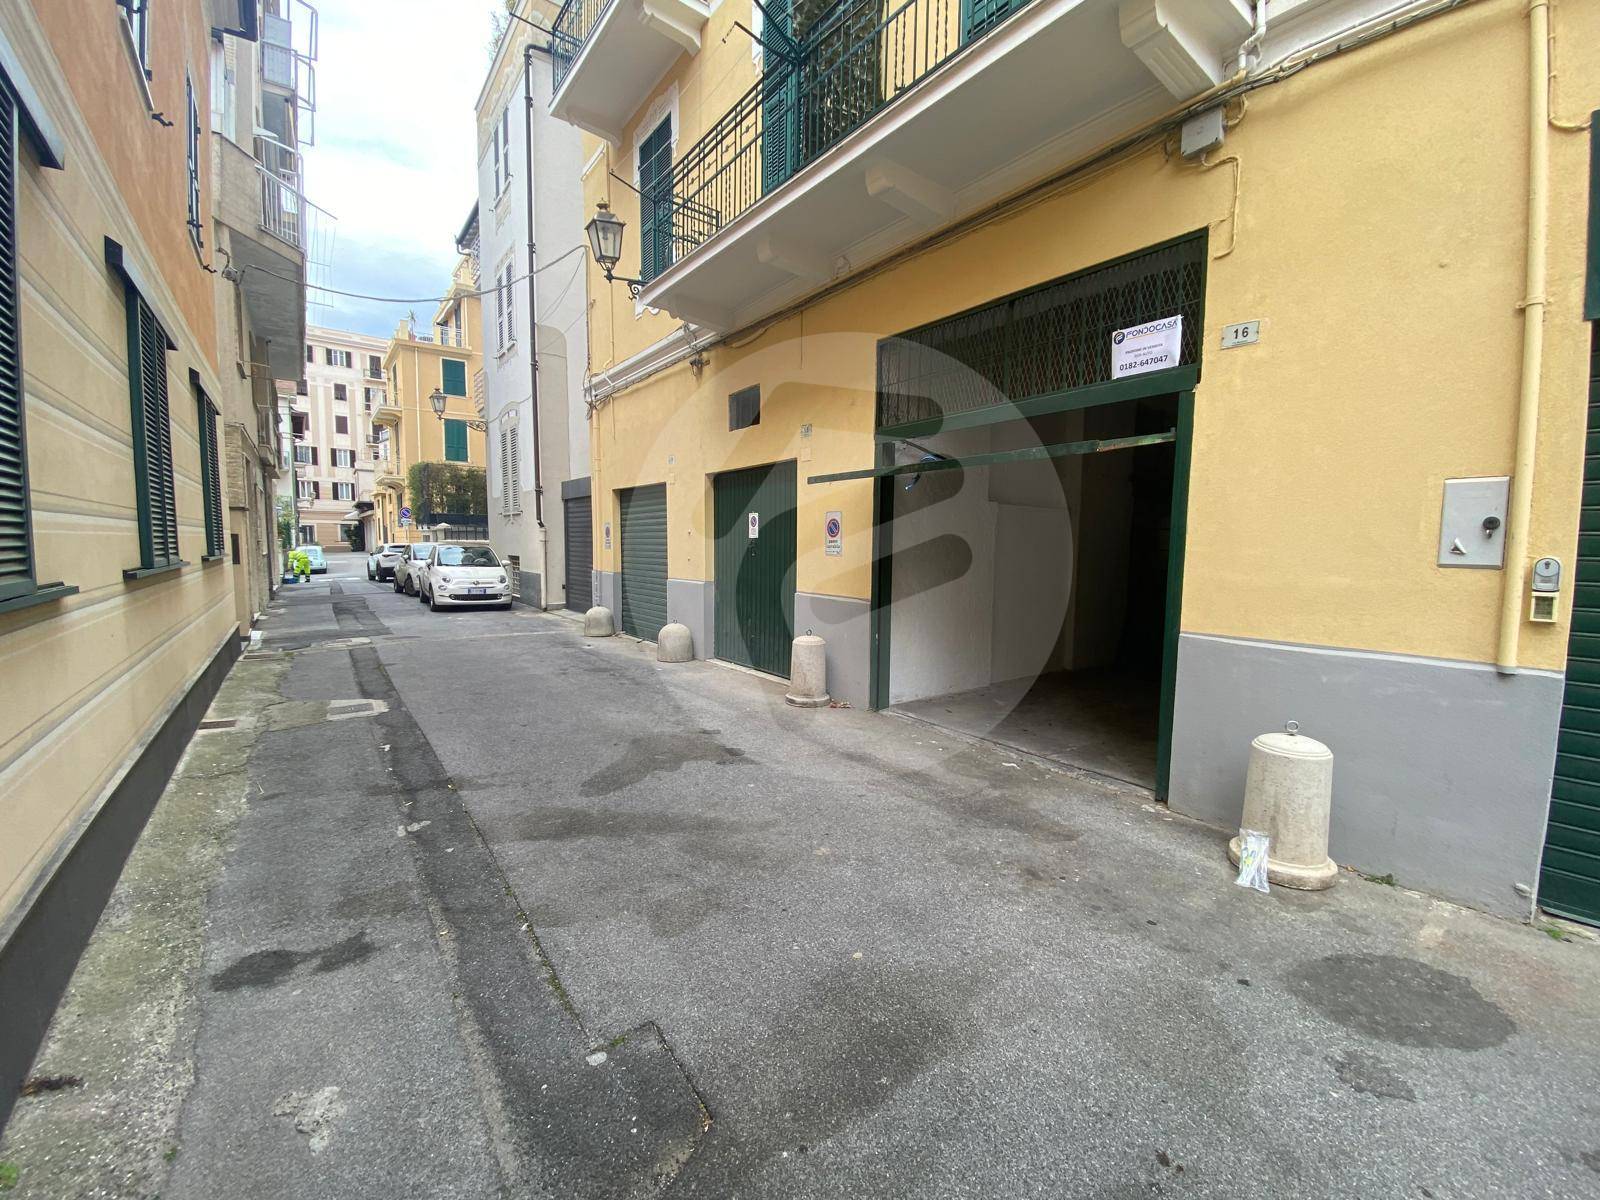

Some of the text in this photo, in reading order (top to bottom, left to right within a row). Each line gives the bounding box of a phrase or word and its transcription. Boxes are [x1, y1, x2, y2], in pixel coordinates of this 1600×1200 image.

[1126, 320, 1178, 338] FONDOCASA
[1233, 326, 1249, 340] 16
[1119, 354, 1168, 371] 0182-647047
